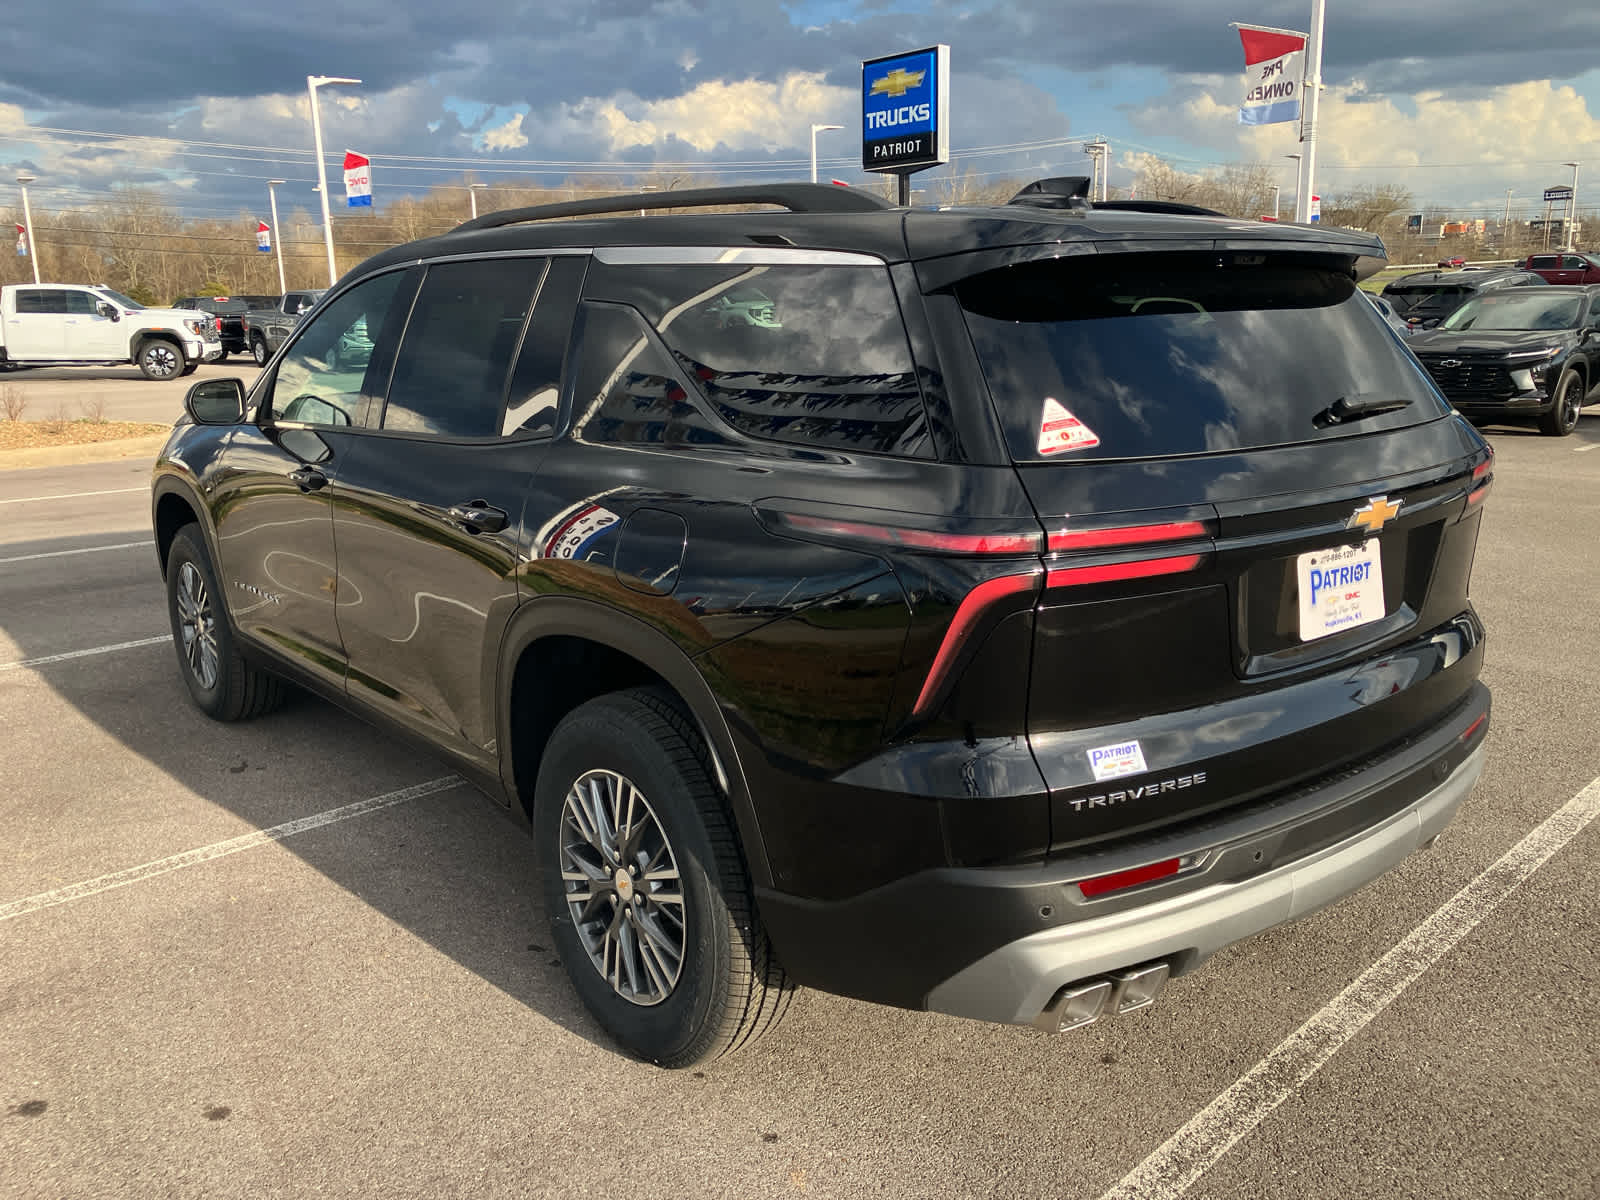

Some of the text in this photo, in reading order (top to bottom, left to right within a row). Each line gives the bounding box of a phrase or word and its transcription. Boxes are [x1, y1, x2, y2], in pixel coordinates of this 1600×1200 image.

[866, 103, 930, 129] TRUCKS
[874, 140, 921, 157] PATRIOT
[1310, 561, 1372, 605] PATRIOT
[1345, 591, 1361, 600] GMC
[1092, 744, 1137, 766] PATRIOT
[1070, 772, 1206, 810] TRAVERSE
